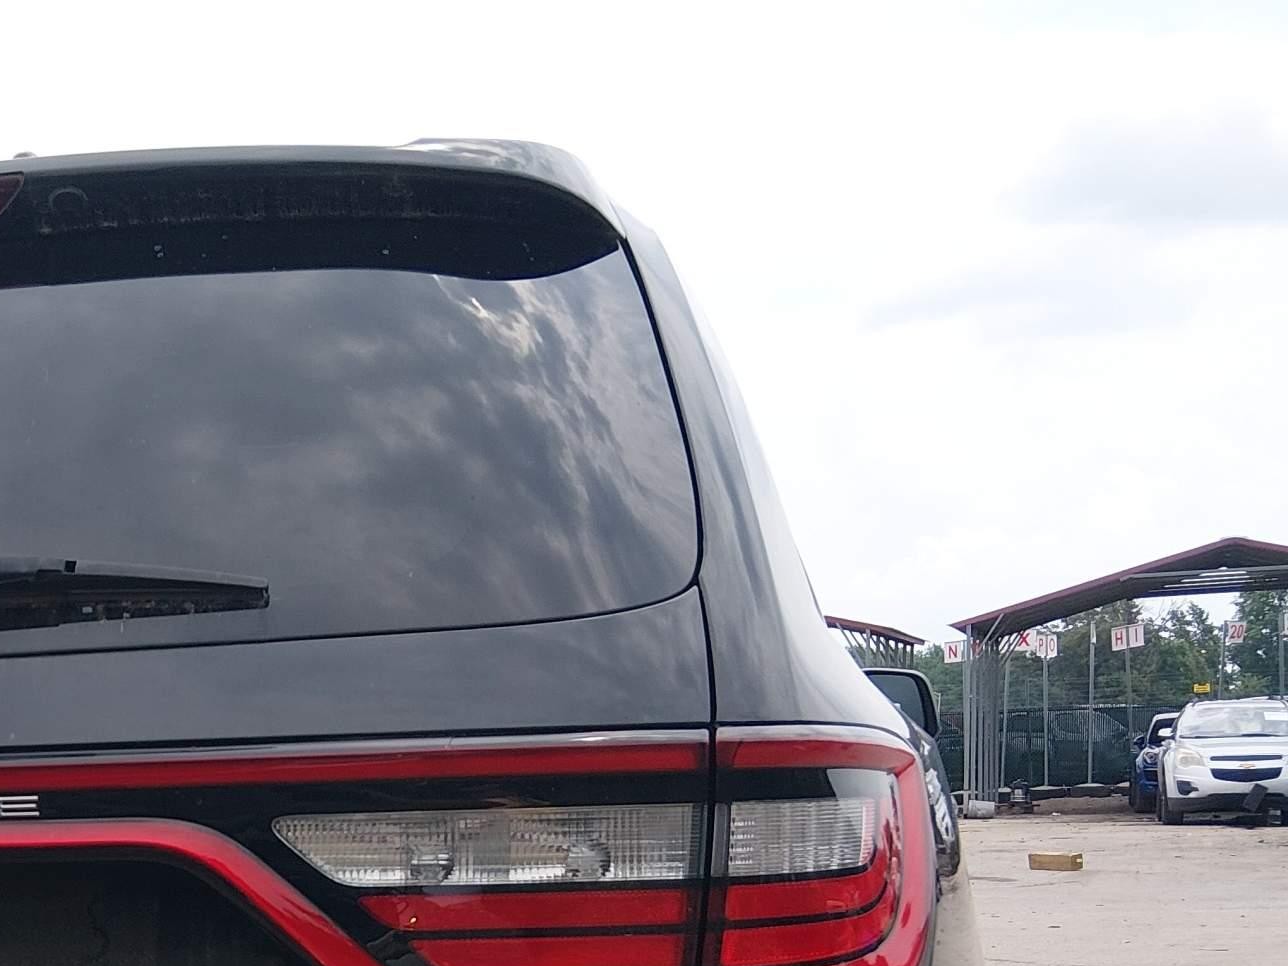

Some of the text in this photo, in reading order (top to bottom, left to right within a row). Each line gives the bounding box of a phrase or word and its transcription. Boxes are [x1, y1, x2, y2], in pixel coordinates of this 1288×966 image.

[1114, 631, 1124, 647] H
[1229, 624, 1244, 639] 20
[948, 645, 958, 659] N
